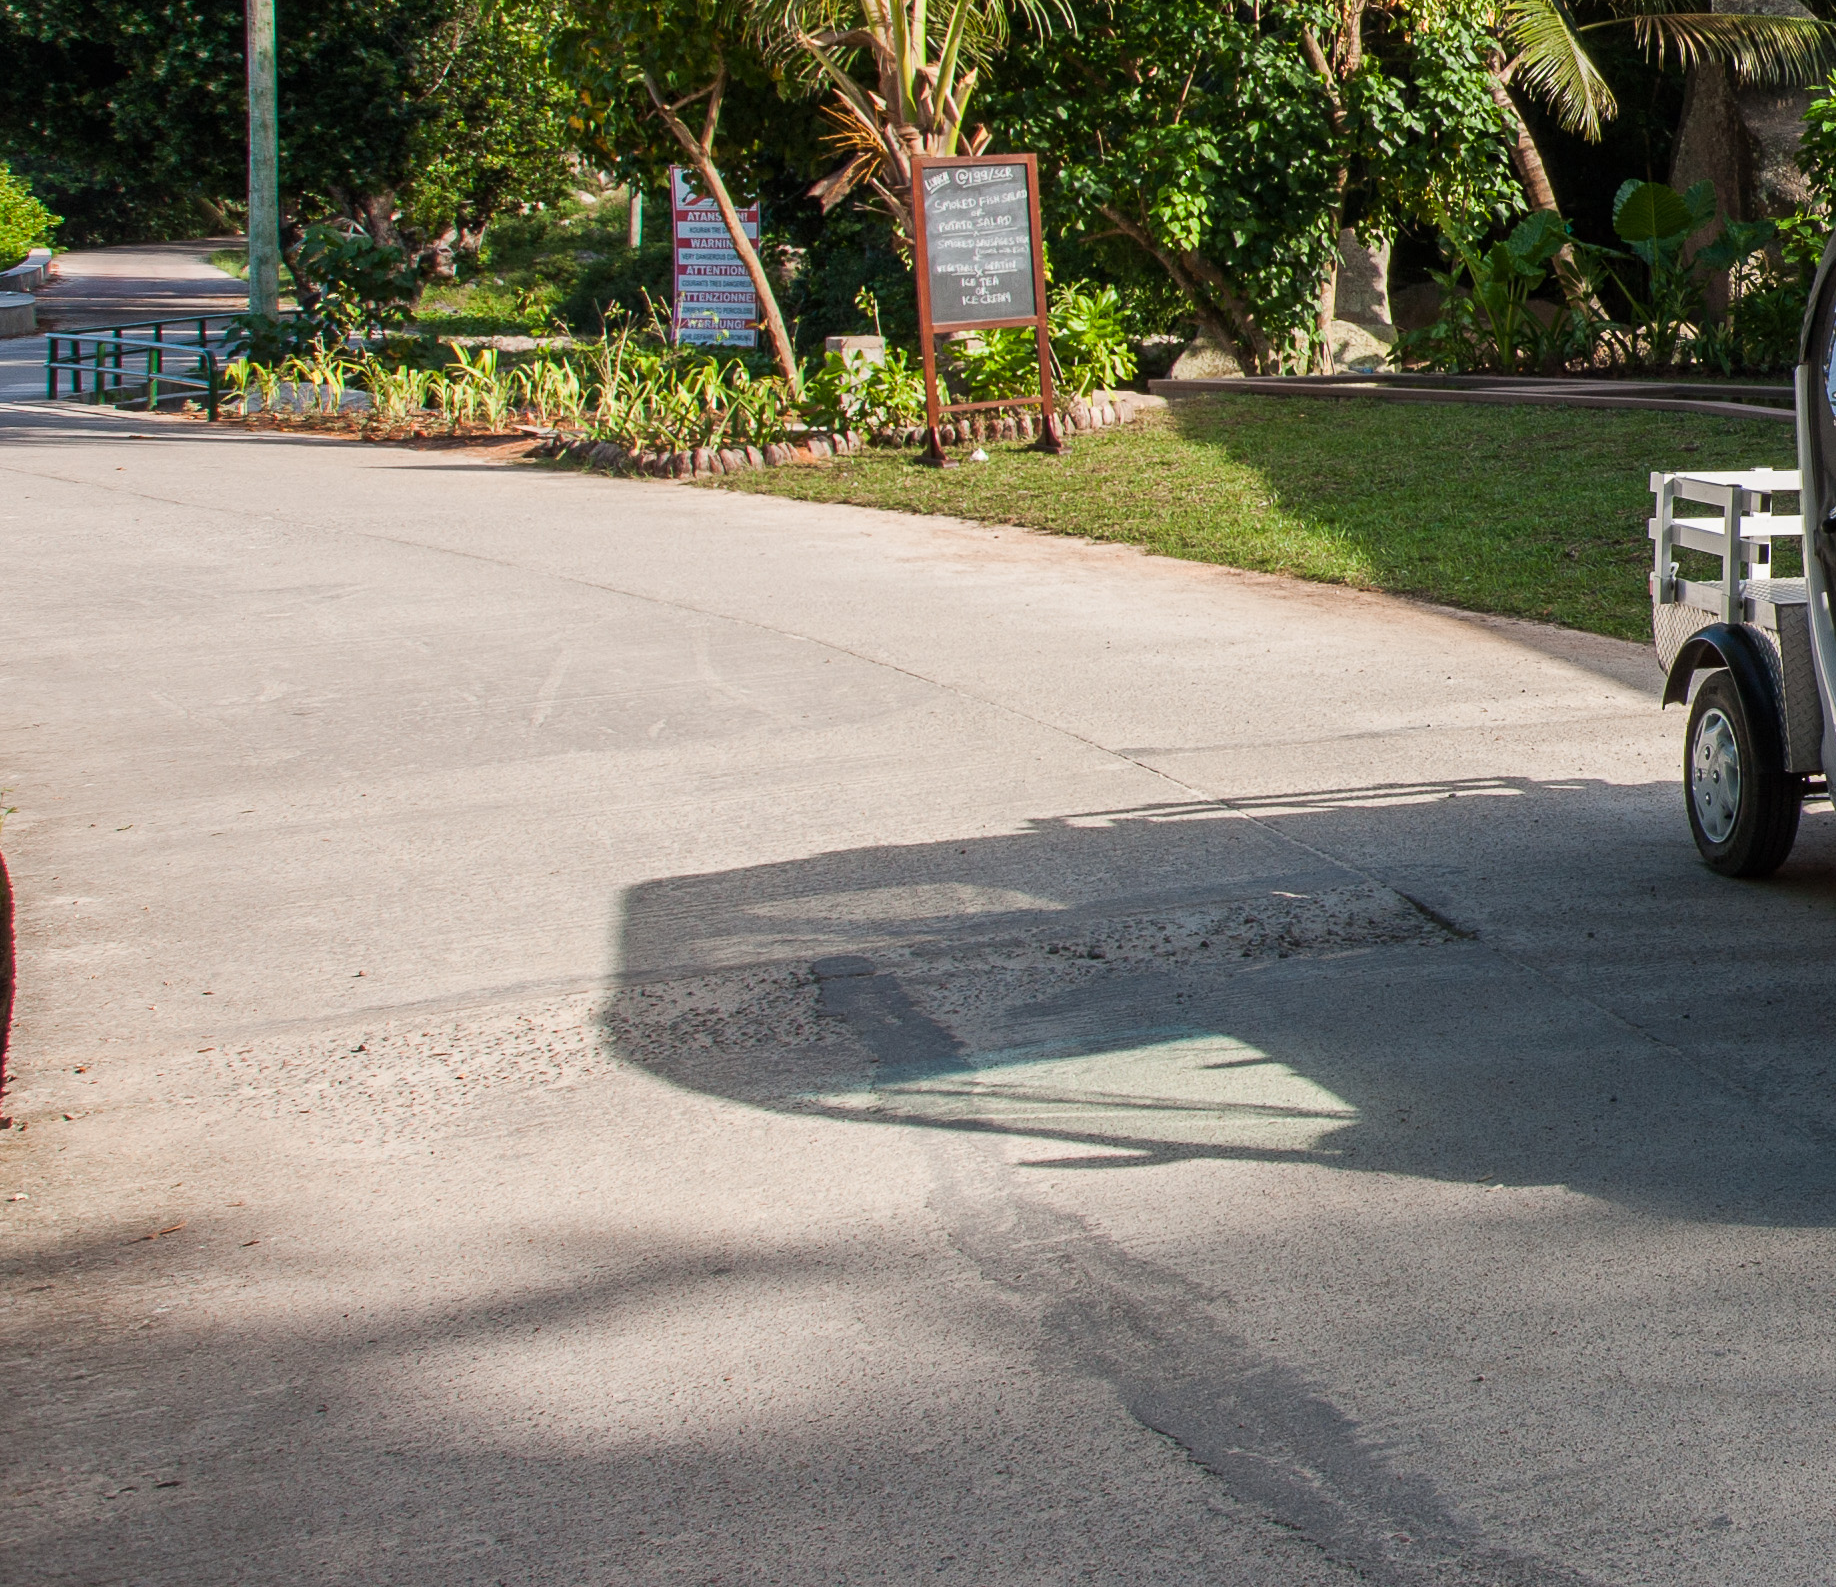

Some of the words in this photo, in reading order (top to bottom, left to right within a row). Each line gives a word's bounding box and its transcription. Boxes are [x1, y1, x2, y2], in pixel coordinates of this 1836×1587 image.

[924, 171, 950, 191] LUNCH
[932, 197, 977, 213] SMOKED
[1001, 189, 1028, 203] SALAD
[687, 211, 748, 222] ATANSN!
[976, 215, 1013, 227] SALAD
[961, 277, 976, 287] ICE
[980, 275, 1000, 287] TEA
[962, 295, 979, 306] ICE
